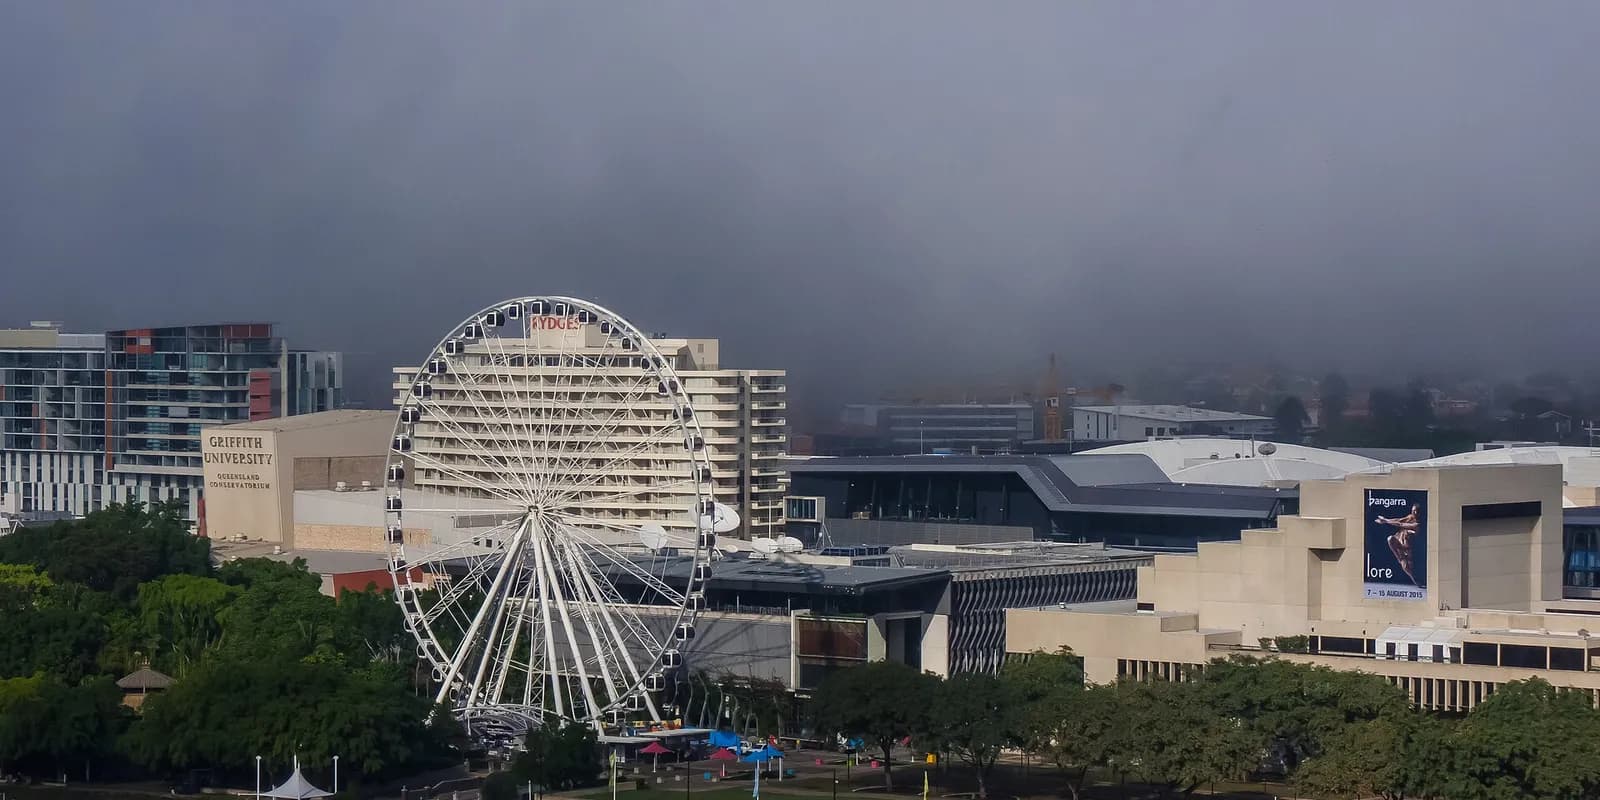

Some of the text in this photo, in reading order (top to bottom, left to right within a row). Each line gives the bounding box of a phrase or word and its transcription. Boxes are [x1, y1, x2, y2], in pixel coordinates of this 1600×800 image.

[532, 316, 580, 330] RYDGES
[209, 436, 263, 449] GRIFFITH
[204, 452, 273, 465] UNIVERSITY
[217, 473, 260, 481] QUEENSLAND
[209, 481, 271, 489] CONSERVATORIUM
[1368, 489, 1407, 508] bangarra
[1367, 552, 1393, 579] lore
[1386, 590, 1408, 598] AUGUST
[1408, 591, 1423, 599] 2015
